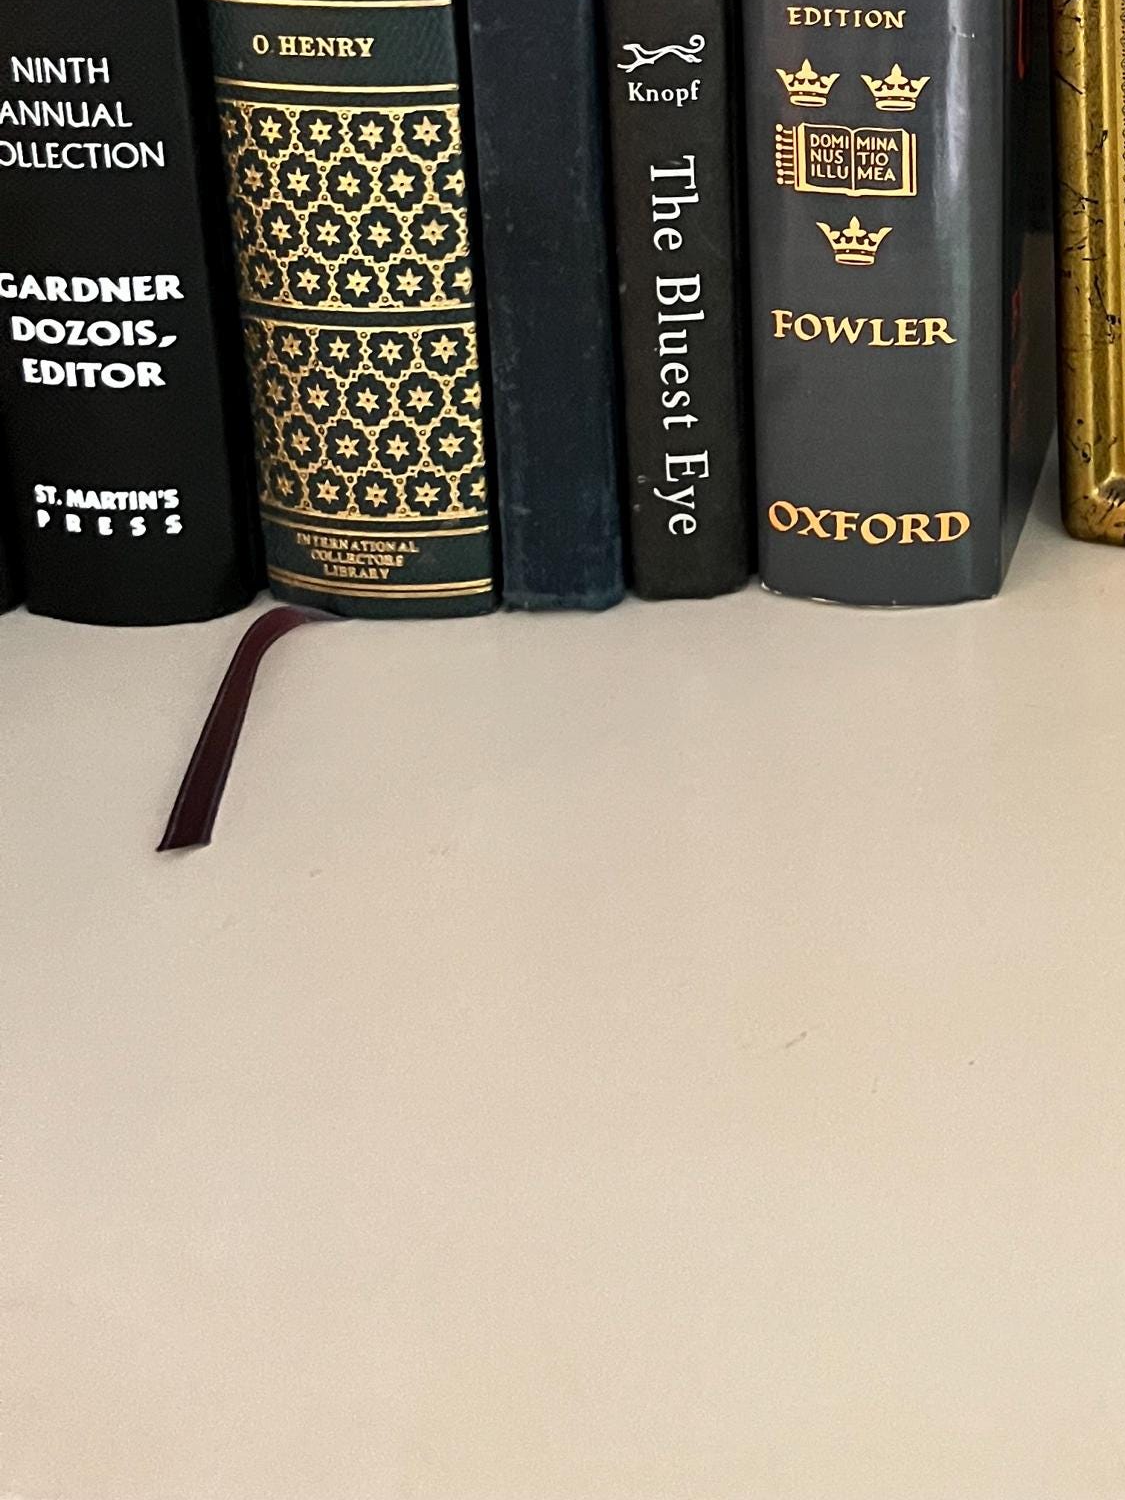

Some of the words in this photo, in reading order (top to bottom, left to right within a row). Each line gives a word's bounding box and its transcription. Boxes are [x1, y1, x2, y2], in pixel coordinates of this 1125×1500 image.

[787, 7, 907, 29] EDITION
[252, 34, 270, 55] O
[278, 35, 375, 58] HENRY
[11, 56, 110, 84] NINTH
[628, 79, 701, 108] Knopf
[0, 100, 133, 128] ANNUAL
[810, 133, 850, 149] DOMI
[856, 136, 900, 152] MINA
[0, 140, 165, 170] OLLECTION
[810, 149, 844, 164] NUS
[857, 151, 890, 167] TIO
[811, 164, 849, 180] ILLU
[857, 166, 897, 182] MEA
[650, 155, 699, 251] The
[0, 272, 185, 303] GARDNER
[12, 315, 177, 348] DOZOIS,
[771, 309, 957, 346] FOWLER
[656, 274, 705, 430] Bluest
[22, 357, 167, 389] EDITOR
[34, 484, 63, 506] ST.
[66, 488, 180, 511] MARTIN'S
[653, 450, 710, 535] Eye
[768, 500, 971, 546] OXFORD
[296, 532, 420, 553] INTERNATIONAL
[311, 549, 405, 567] COLLECTORS
[324, 563, 390, 580] LIBRARY
